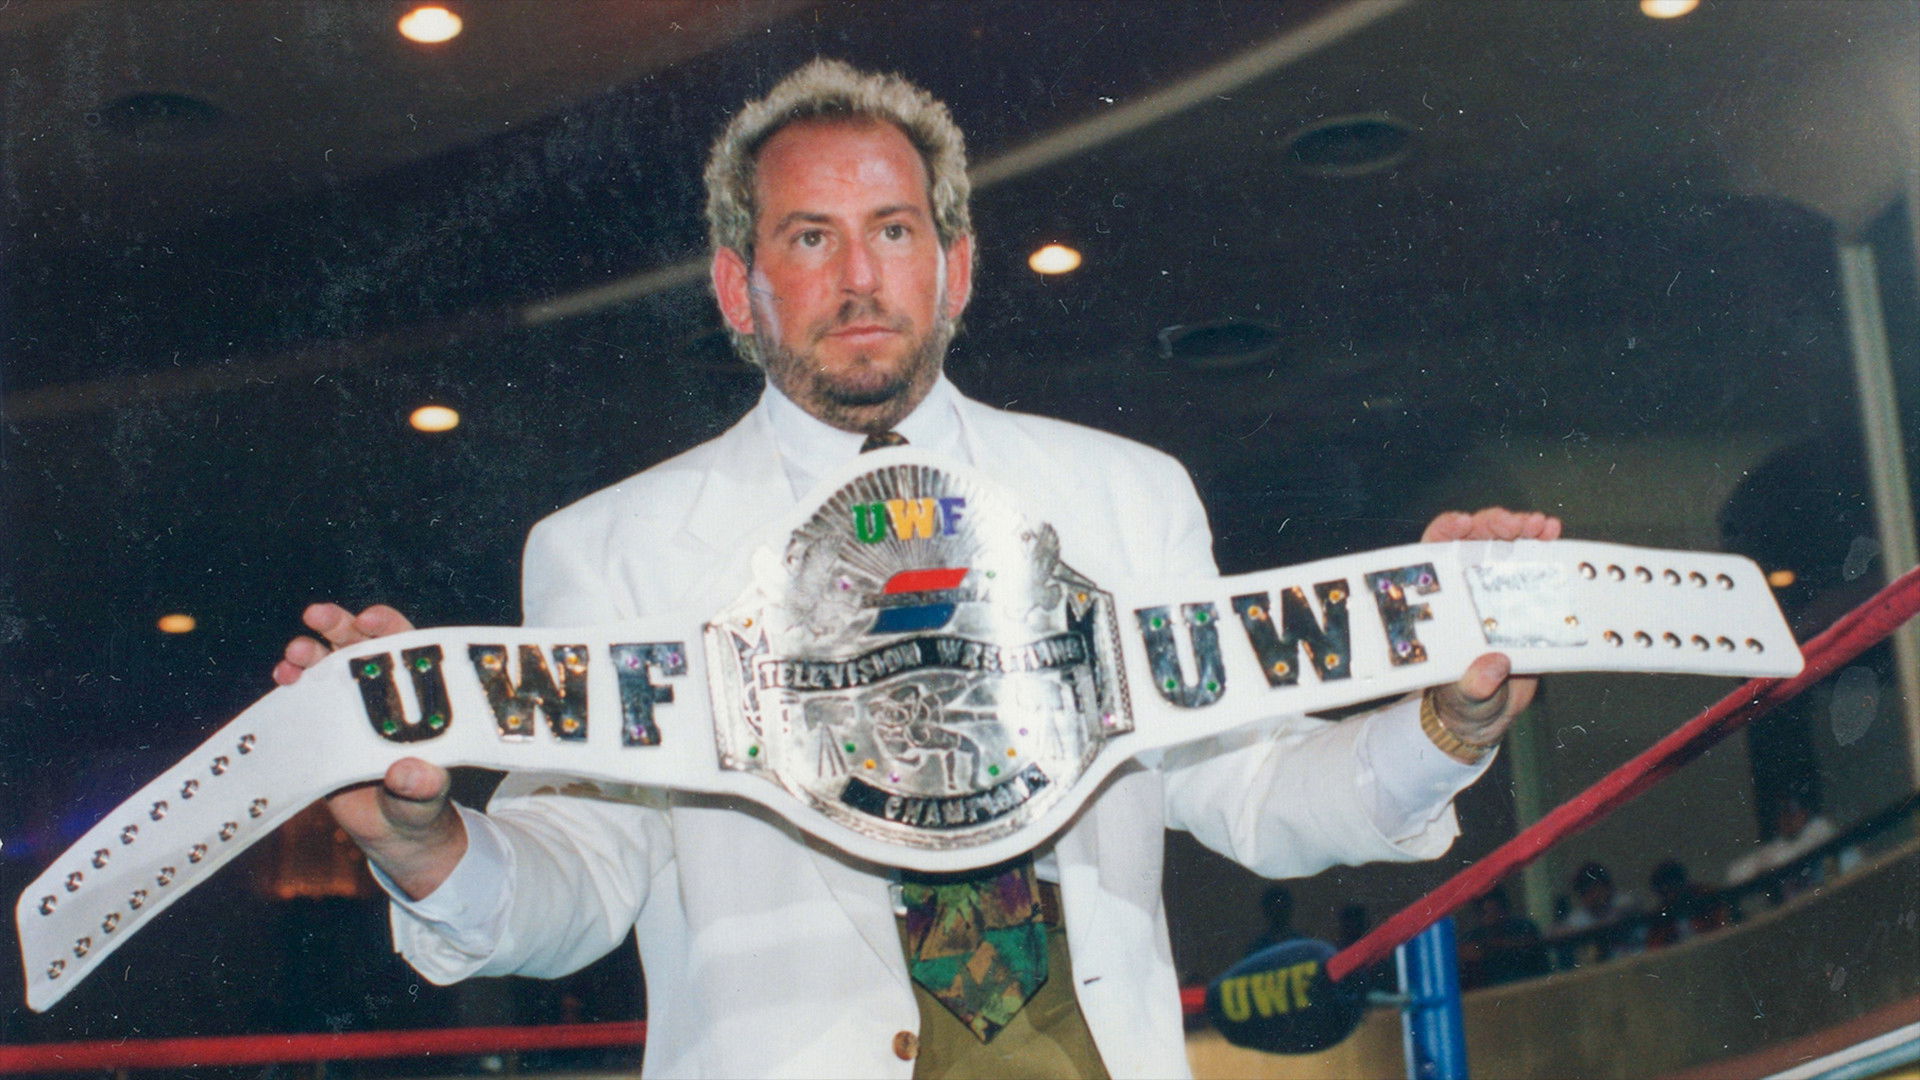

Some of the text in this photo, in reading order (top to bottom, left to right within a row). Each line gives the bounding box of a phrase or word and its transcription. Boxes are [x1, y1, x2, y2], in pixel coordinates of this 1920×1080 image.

[851, 497, 966, 544] UWF
[760, 641, 922, 689] TELEVISION
[1134, 562, 1441, 708] UWF
[349, 641, 688, 748] UWF
[1220, 960, 1319, 1022] UWF
